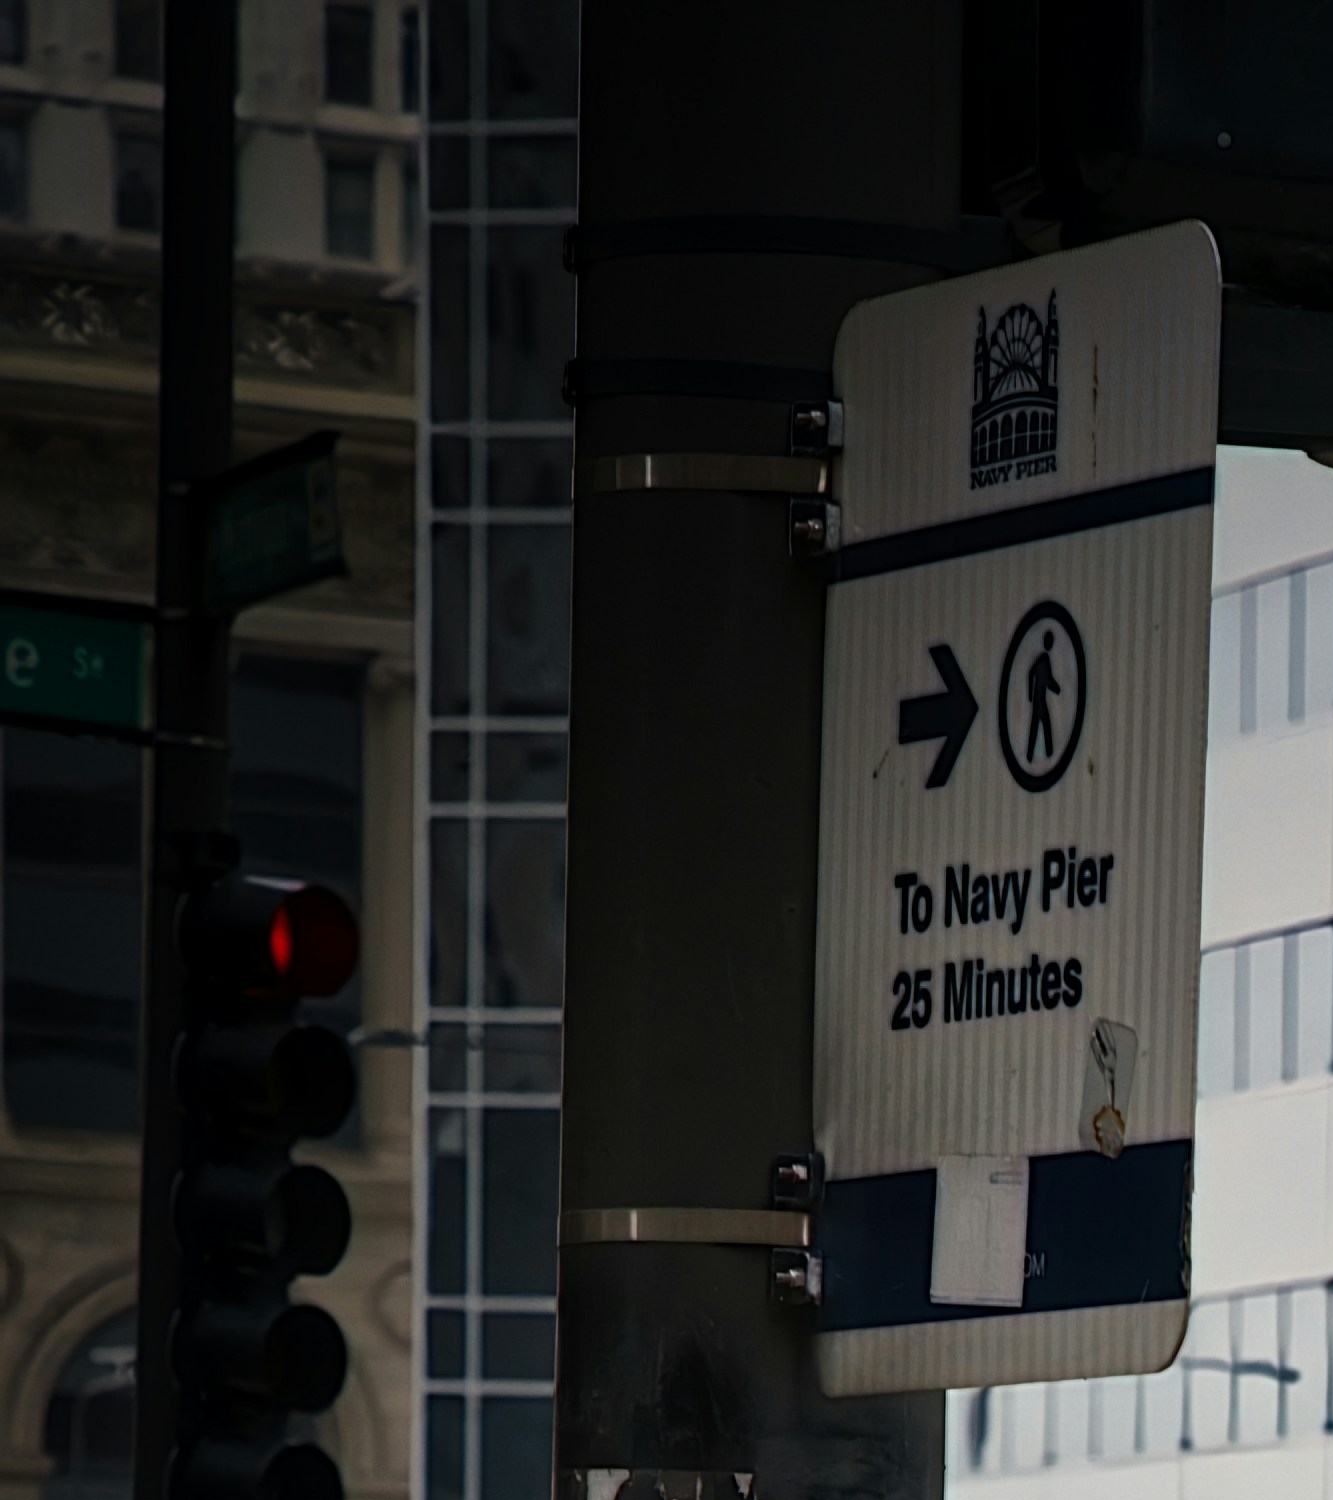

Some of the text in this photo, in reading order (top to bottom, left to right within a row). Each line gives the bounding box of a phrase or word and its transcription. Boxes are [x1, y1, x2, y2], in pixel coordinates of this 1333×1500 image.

[969, 454, 1057, 491] NAVY PIER
[894, 846, 1115, 936] To Navy Pier
[891, 953, 1083, 1031] 25 Minutes
